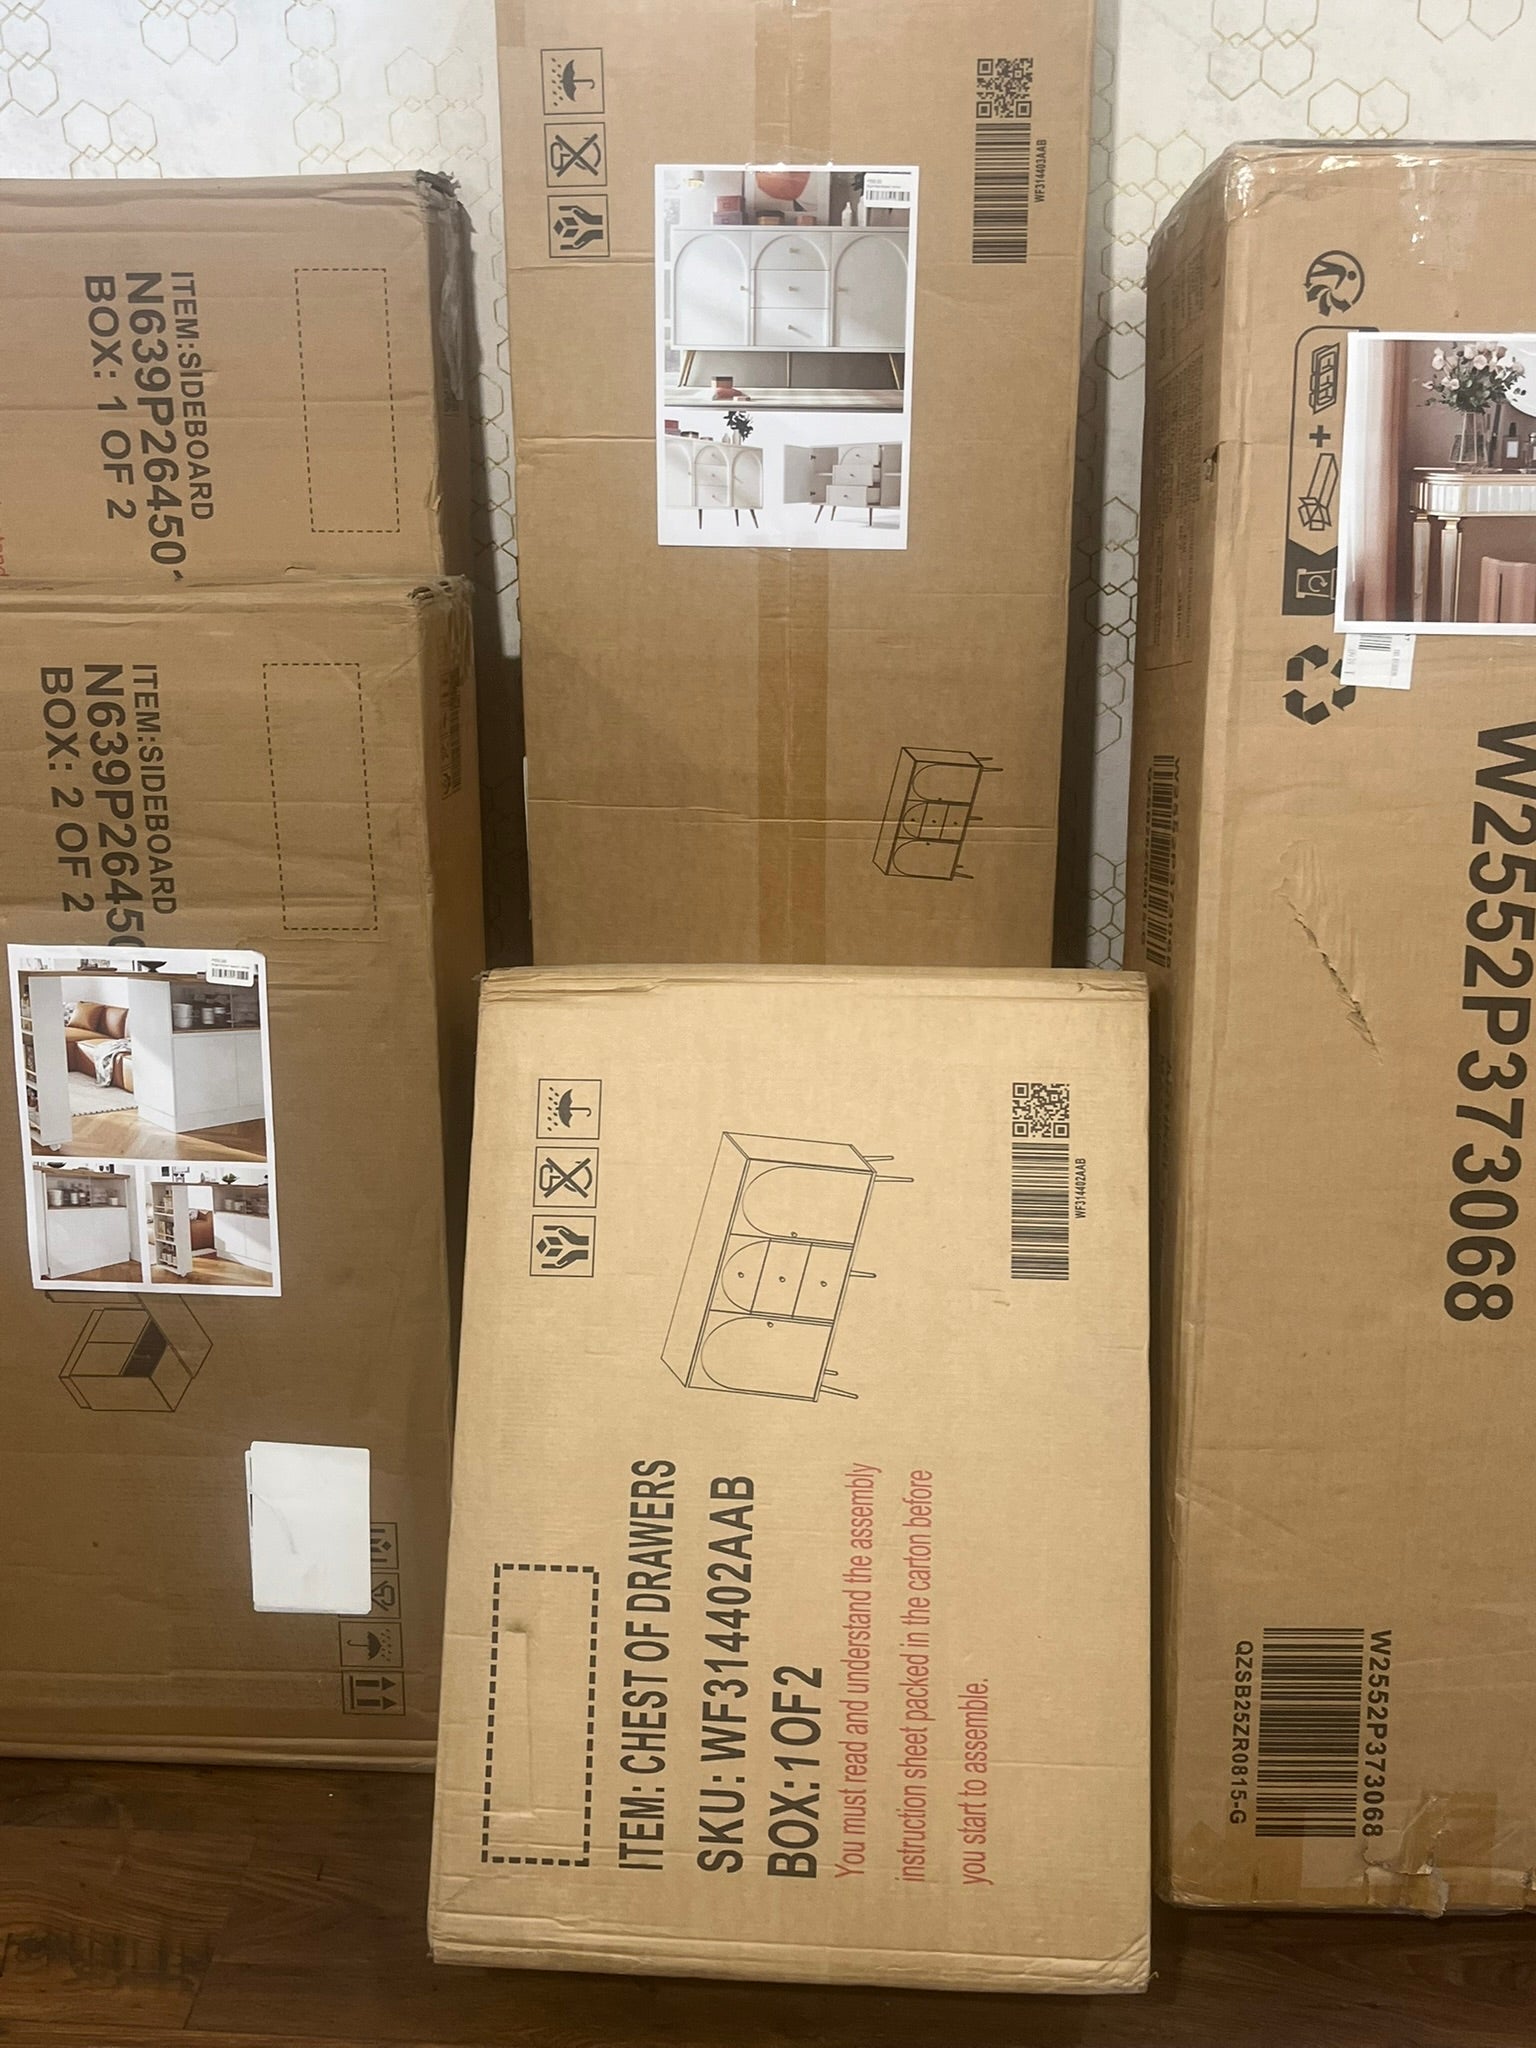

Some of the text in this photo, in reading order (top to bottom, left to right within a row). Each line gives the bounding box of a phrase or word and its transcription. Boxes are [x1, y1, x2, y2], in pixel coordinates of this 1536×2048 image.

[1035, 139, 1048, 203] WF314403AAB
[85, 276, 136, 519] BOX: 1 OF 2
[125, 272, 187, 581] N639P26450
[171, 271, 213, 520] ITEM:SIDEBOARD
[41, 668, 94, 911] BOX: 2 OF 2
[132, 664, 176, 914] ITEM:SIDEBOARD
[1444, 721, 1536, 1321] W2552P373068
[1074, 1157, 1086, 1218] WF314402AAB
[619, 1461, 676, 1870] ITEM: CHEST OF DRAWERS
[697, 1477, 753, 1873] SKU: WF314402AAB
[835, 1463, 882, 1878] You must read and understand the assembly
[895, 1470, 936, 1882] instruction sheet packed in the carton before
[957, 1679, 994, 1885] you start to assemble.
[1230, 1641, 1253, 1824] QZSB25ZR0815-G
[1362, 1630, 1391, 1837] W2552P373068
